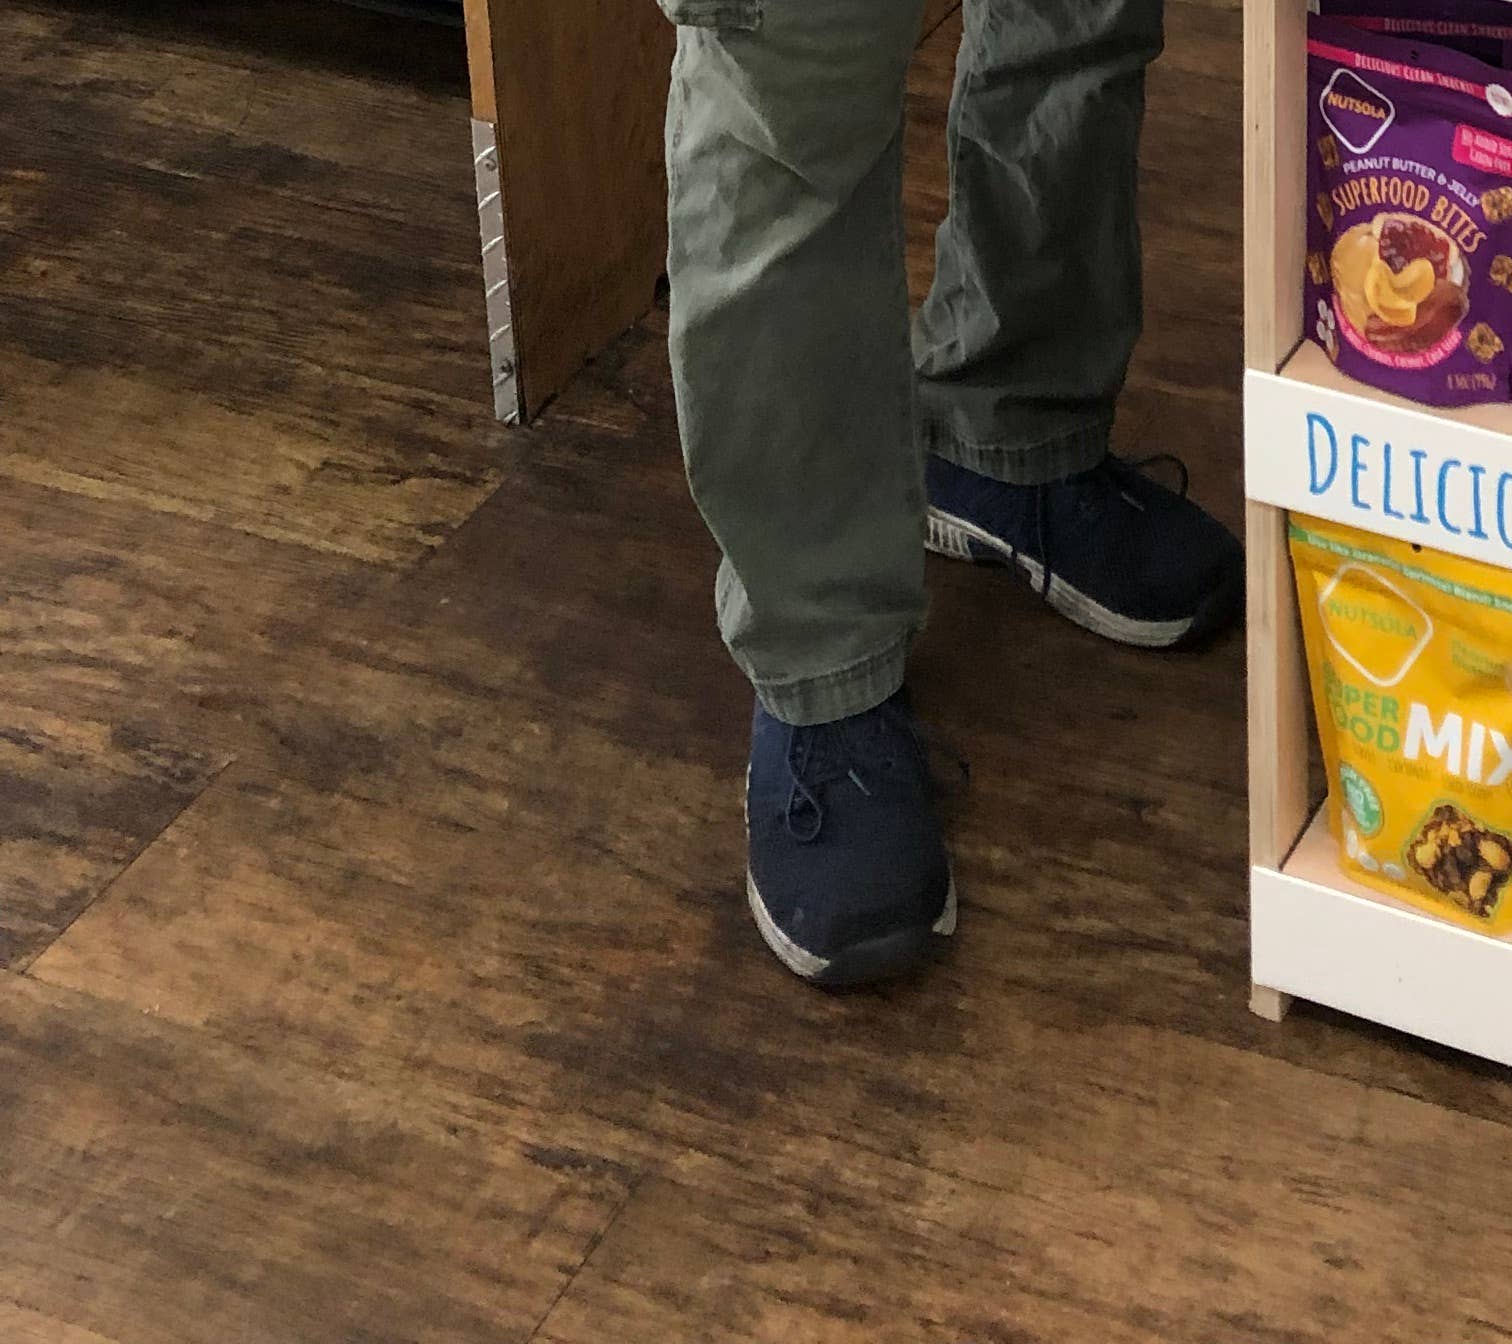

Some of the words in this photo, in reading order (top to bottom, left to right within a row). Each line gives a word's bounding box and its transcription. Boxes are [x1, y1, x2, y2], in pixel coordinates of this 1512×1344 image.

[1331, 176, 1429, 216] SUPERFOOD
[1432, 198, 1486, 252] BITES
[1342, 157, 1390, 175] PEANUT
[1392, 157, 1435, 181] BUTTER
[1447, 176, 1482, 208] JELLY
